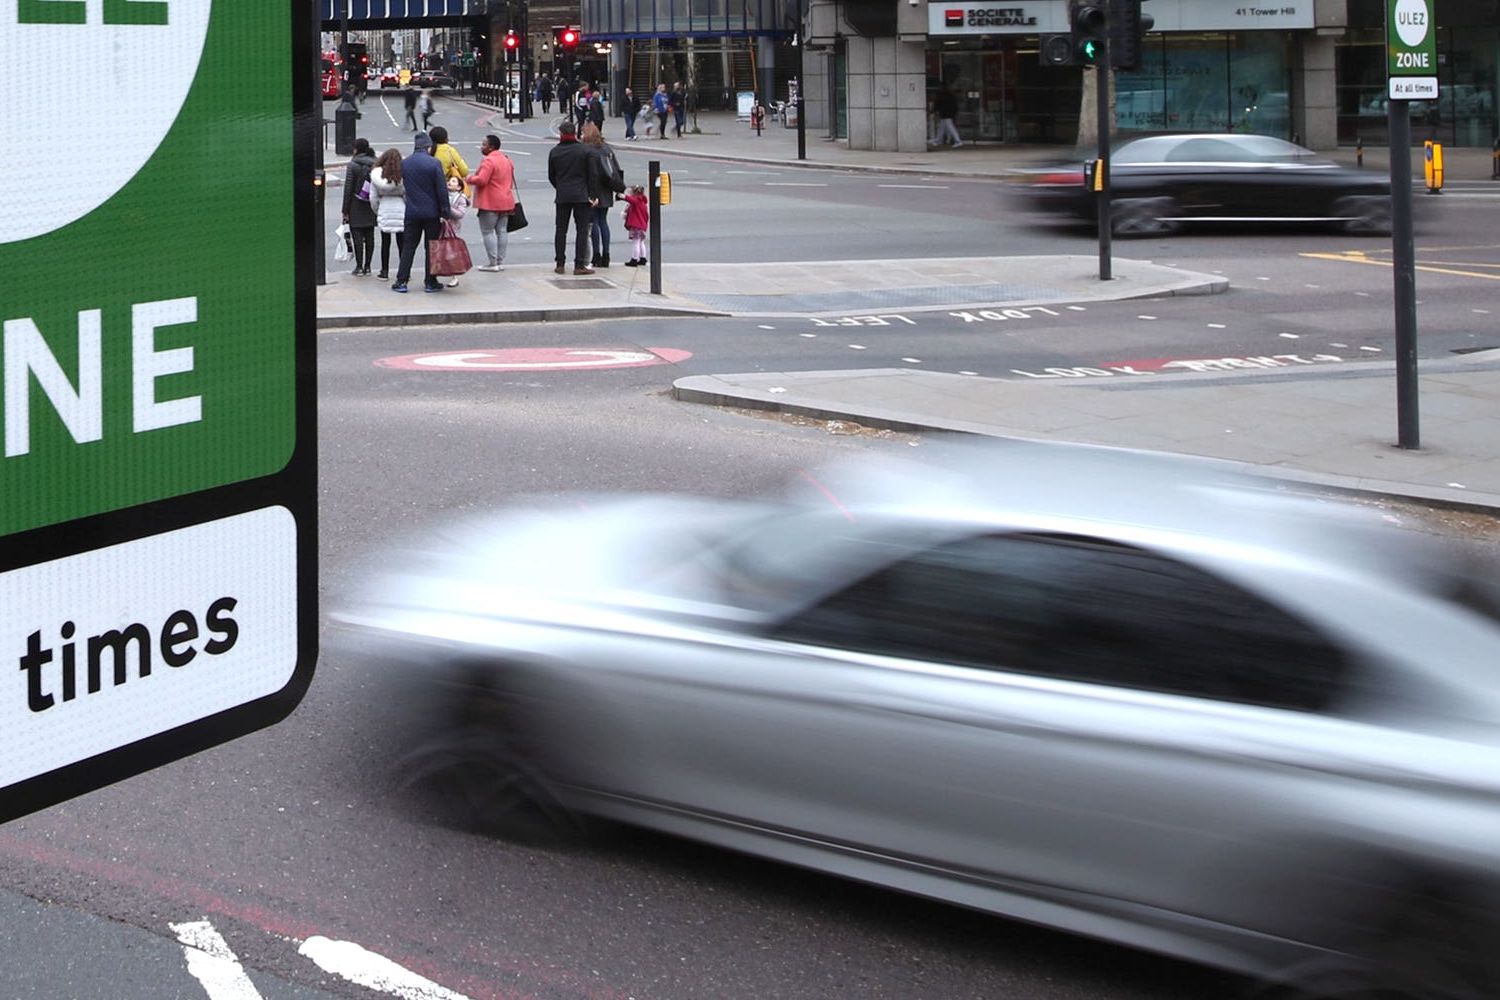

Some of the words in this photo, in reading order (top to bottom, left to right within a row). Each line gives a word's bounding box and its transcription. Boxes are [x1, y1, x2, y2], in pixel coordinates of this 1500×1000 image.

[967, 8, 1024, 17] SOCIETE
[1236, 8, 1246, 16] 41
[1250, 8, 1278, 16] Tower
[1280, 7, 1295, 15] Hill
[967, 17, 1037, 26] GENERALE
[1398, 12, 1425, 25] ULEZ
[1396, 52, 1429, 68] ZONE
[1395, 84, 1403, 93] At
[1405, 84, 1414, 93] all
[1415, 84, 1433, 93] times
[810, 314, 917, 326] LEFT
[949, 306, 1061, 323] LOOK
[1010, 365, 1155, 378] LOOK
[19, 596, 240, 713] times
